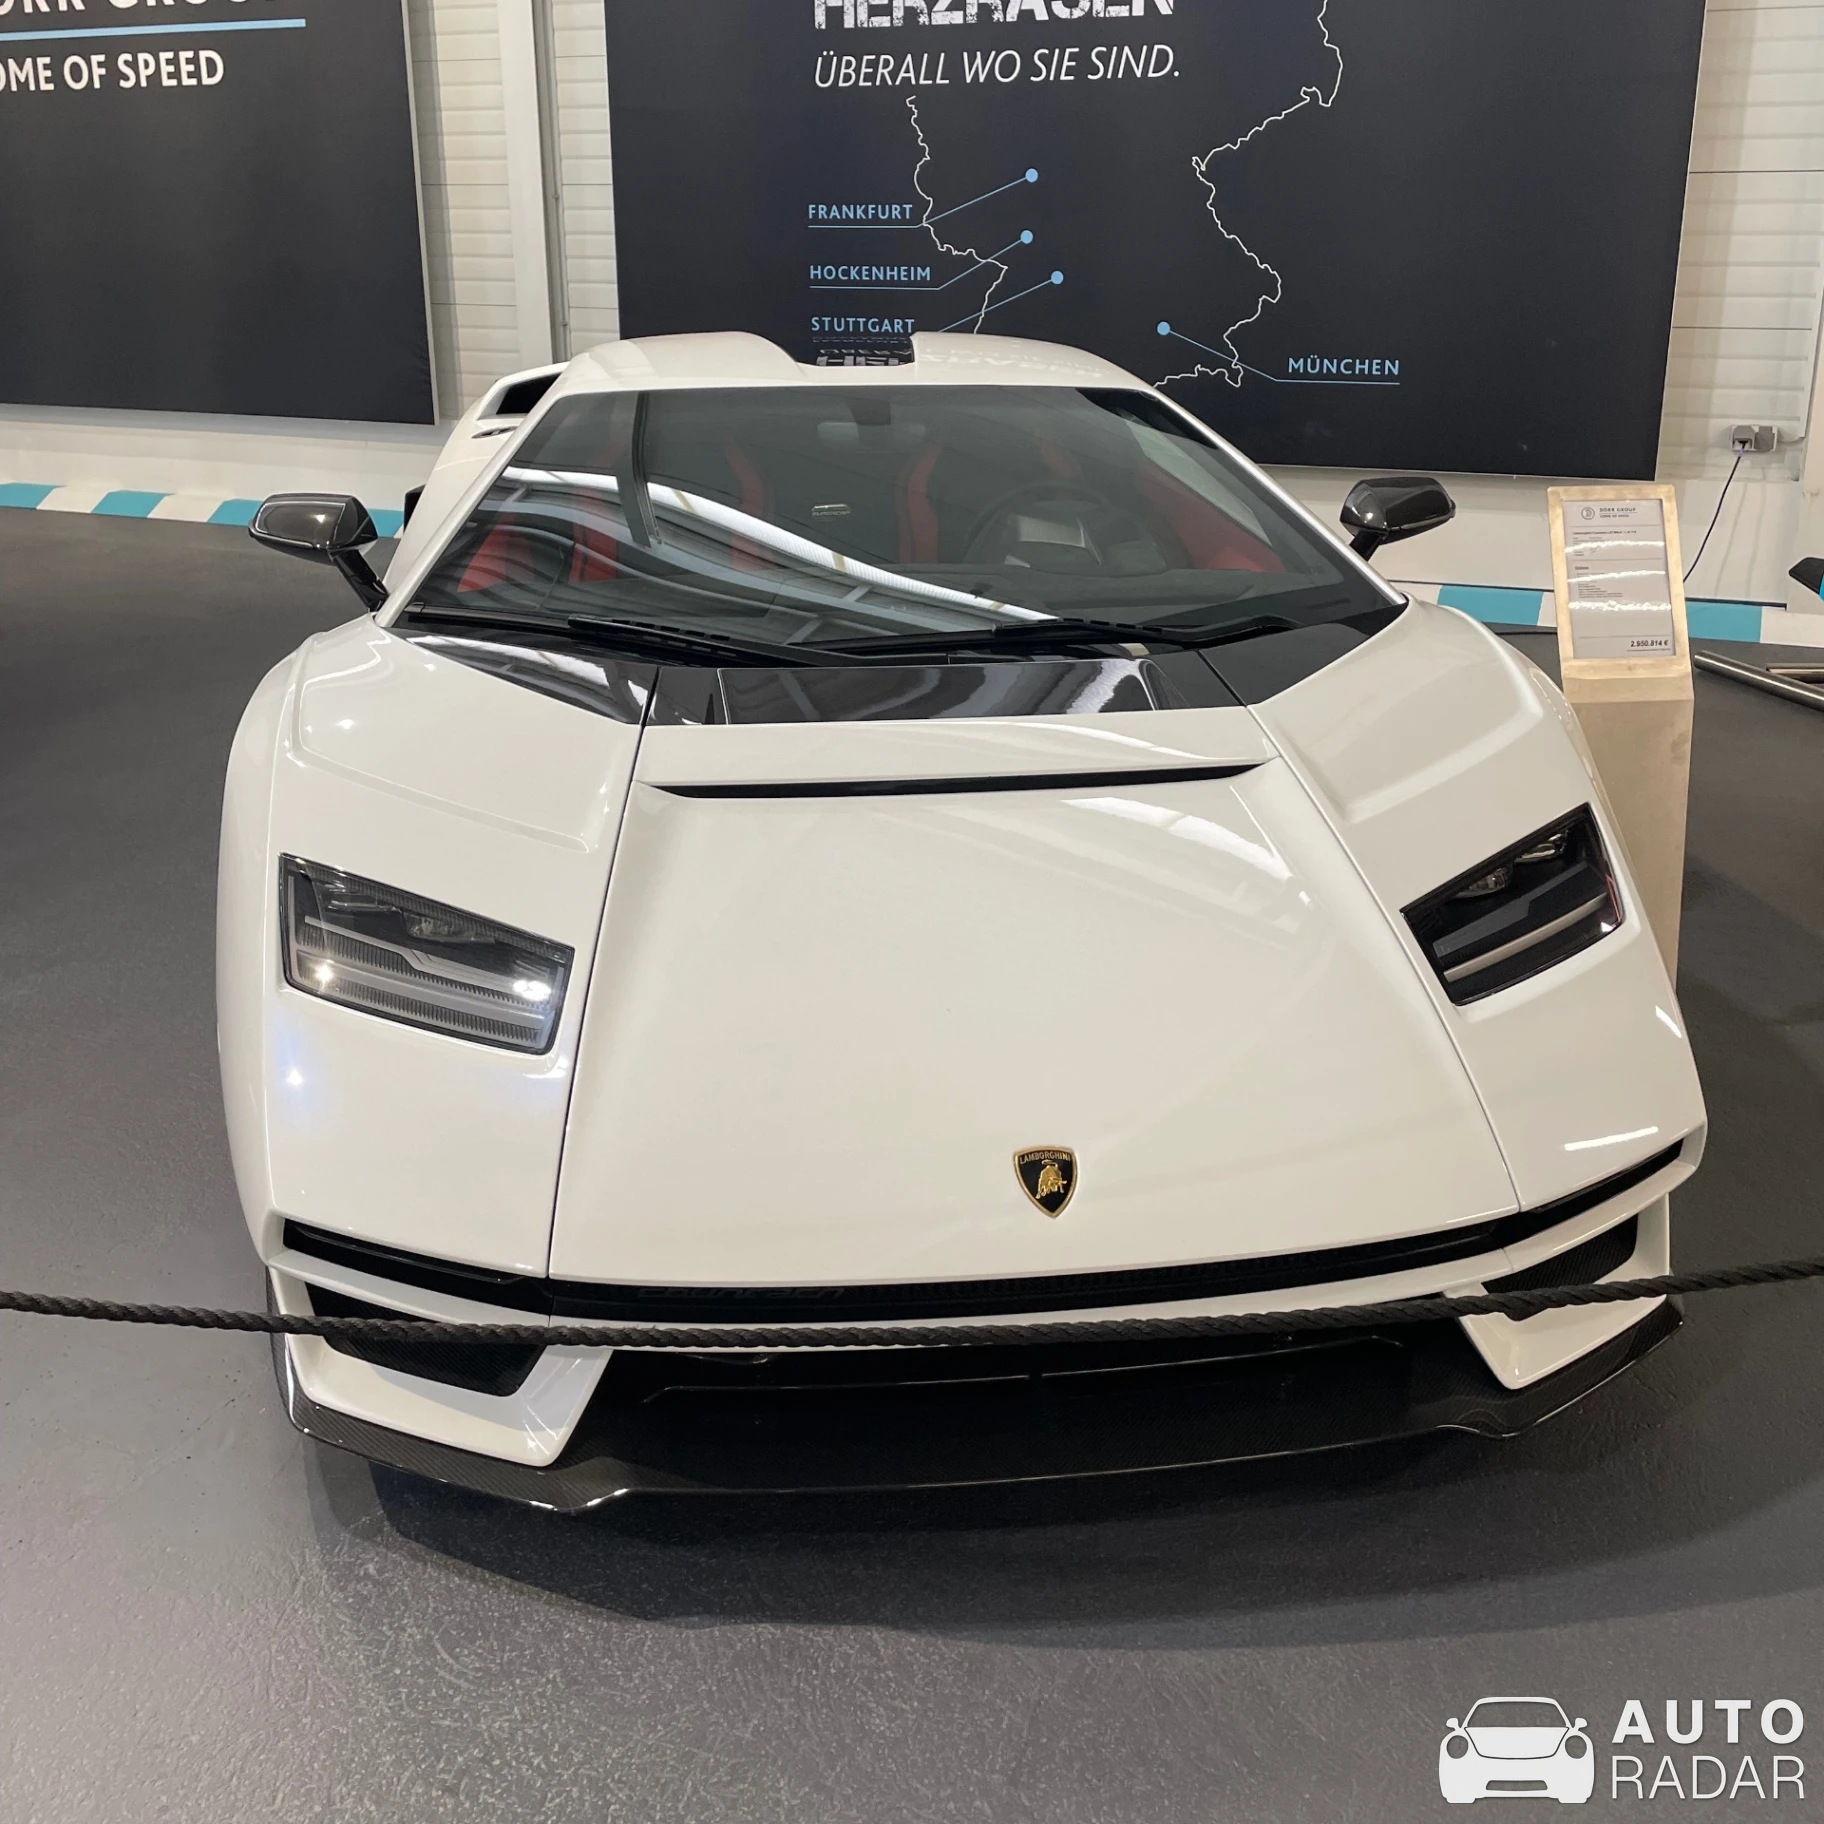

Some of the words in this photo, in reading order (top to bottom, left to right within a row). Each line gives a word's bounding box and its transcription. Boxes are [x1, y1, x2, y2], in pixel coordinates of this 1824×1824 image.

[0, 57, 55, 92] ME
[63, 54, 107, 90] OF
[117, 50, 224, 88] SPEED
[815, 50, 950, 87] ÜBERALL
[962, 50, 1021, 84] WO
[1029, 48, 1080, 82] SIE
[1087, 45, 1180, 80] SIND.
[808, 204, 913, 219] FRANKFURT
[809, 265, 931, 281] HOCKENHEIM
[811, 317, 915, 333] STUTTGART
[1288, 354, 1399, 375] MÜNCHEN
[1020, 1151, 1071, 1164] LAMBORGHINI
